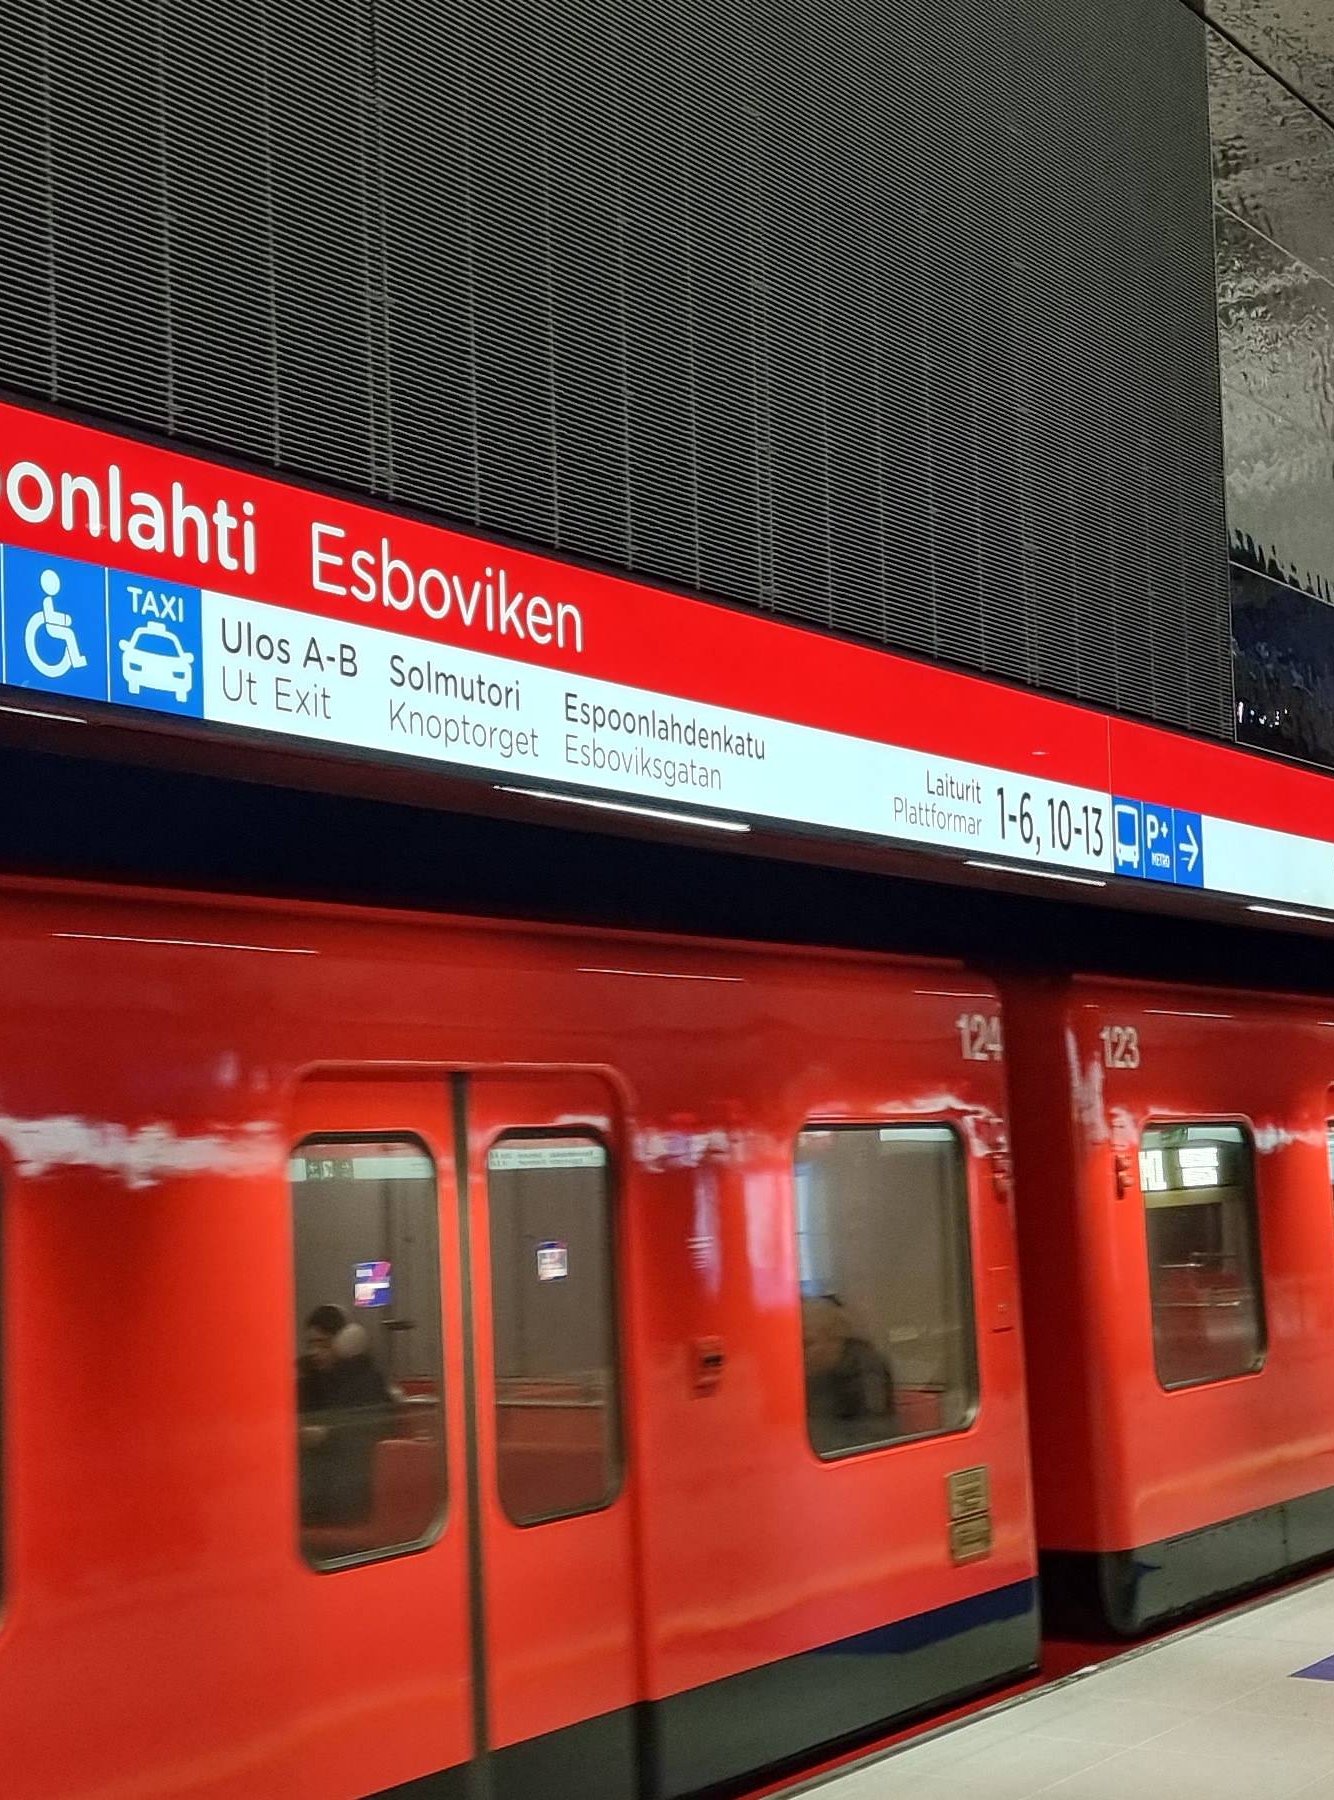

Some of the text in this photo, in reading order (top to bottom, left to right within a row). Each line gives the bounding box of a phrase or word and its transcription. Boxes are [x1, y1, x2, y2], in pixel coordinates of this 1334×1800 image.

[126, 586, 184, 623] TAXI
[311, 523, 583, 653] Esboviken
[221, 617, 359, 679] Ulos A-B
[222, 666, 332, 721] Ut Exit
[390, 654, 521, 712] Solmutori
[389, 701, 539, 760] Knoptorget
[565, 691, 766, 762] Espoonlahdenkatu
[565, 734, 722, 792] Esboviksgatan
[926, 770, 981, 805] Laiturit
[894, 796, 982, 837] Plattformar
[997, 787, 1103, 857] 1-6, 10-13
[955, 1013, 1003, 1061] 124
[1099, 1025, 1141, 1069] 123
